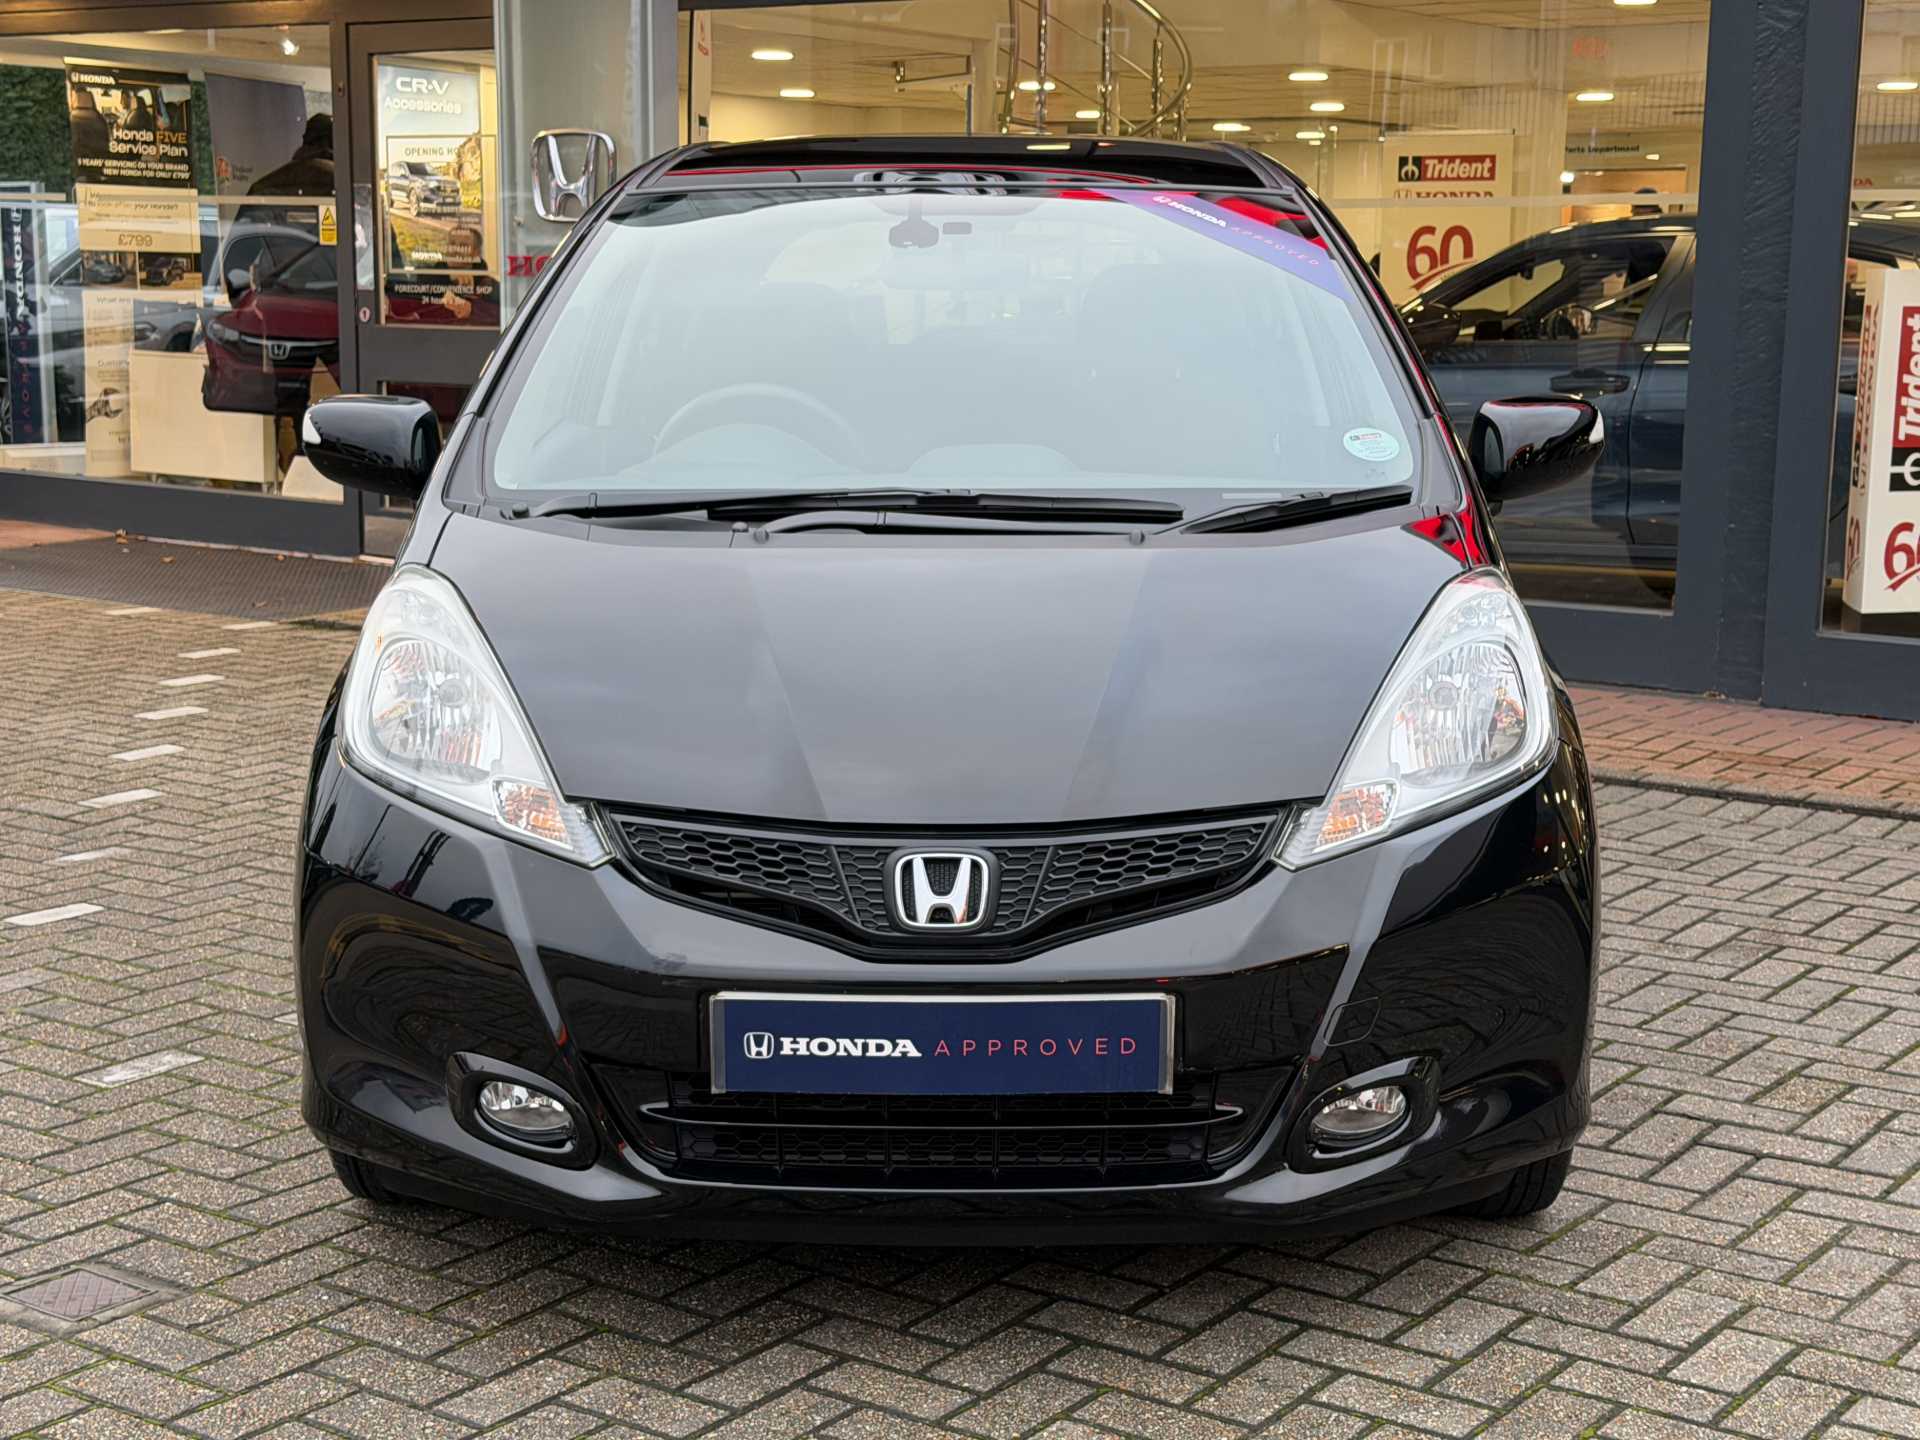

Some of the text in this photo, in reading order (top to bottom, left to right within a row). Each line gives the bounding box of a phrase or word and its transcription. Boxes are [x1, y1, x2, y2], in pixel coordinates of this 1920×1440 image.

[80, 73, 116, 84] HONDA
[384, 96, 462, 113] Accessories
[113, 128, 188, 144] Honda FIVE
[109, 141, 188, 157] Service Plan
[404, 146, 446, 157] OPENING
[1425, 157, 1492, 178] Trident
[1168, 200, 1227, 228] HONDA
[118, 233, 153, 247] £799
[1407, 225, 1473, 281] 60
[14, 225, 25, 317] HONDA
[779, 1036, 1137, 1058] HONDA APPROVED
